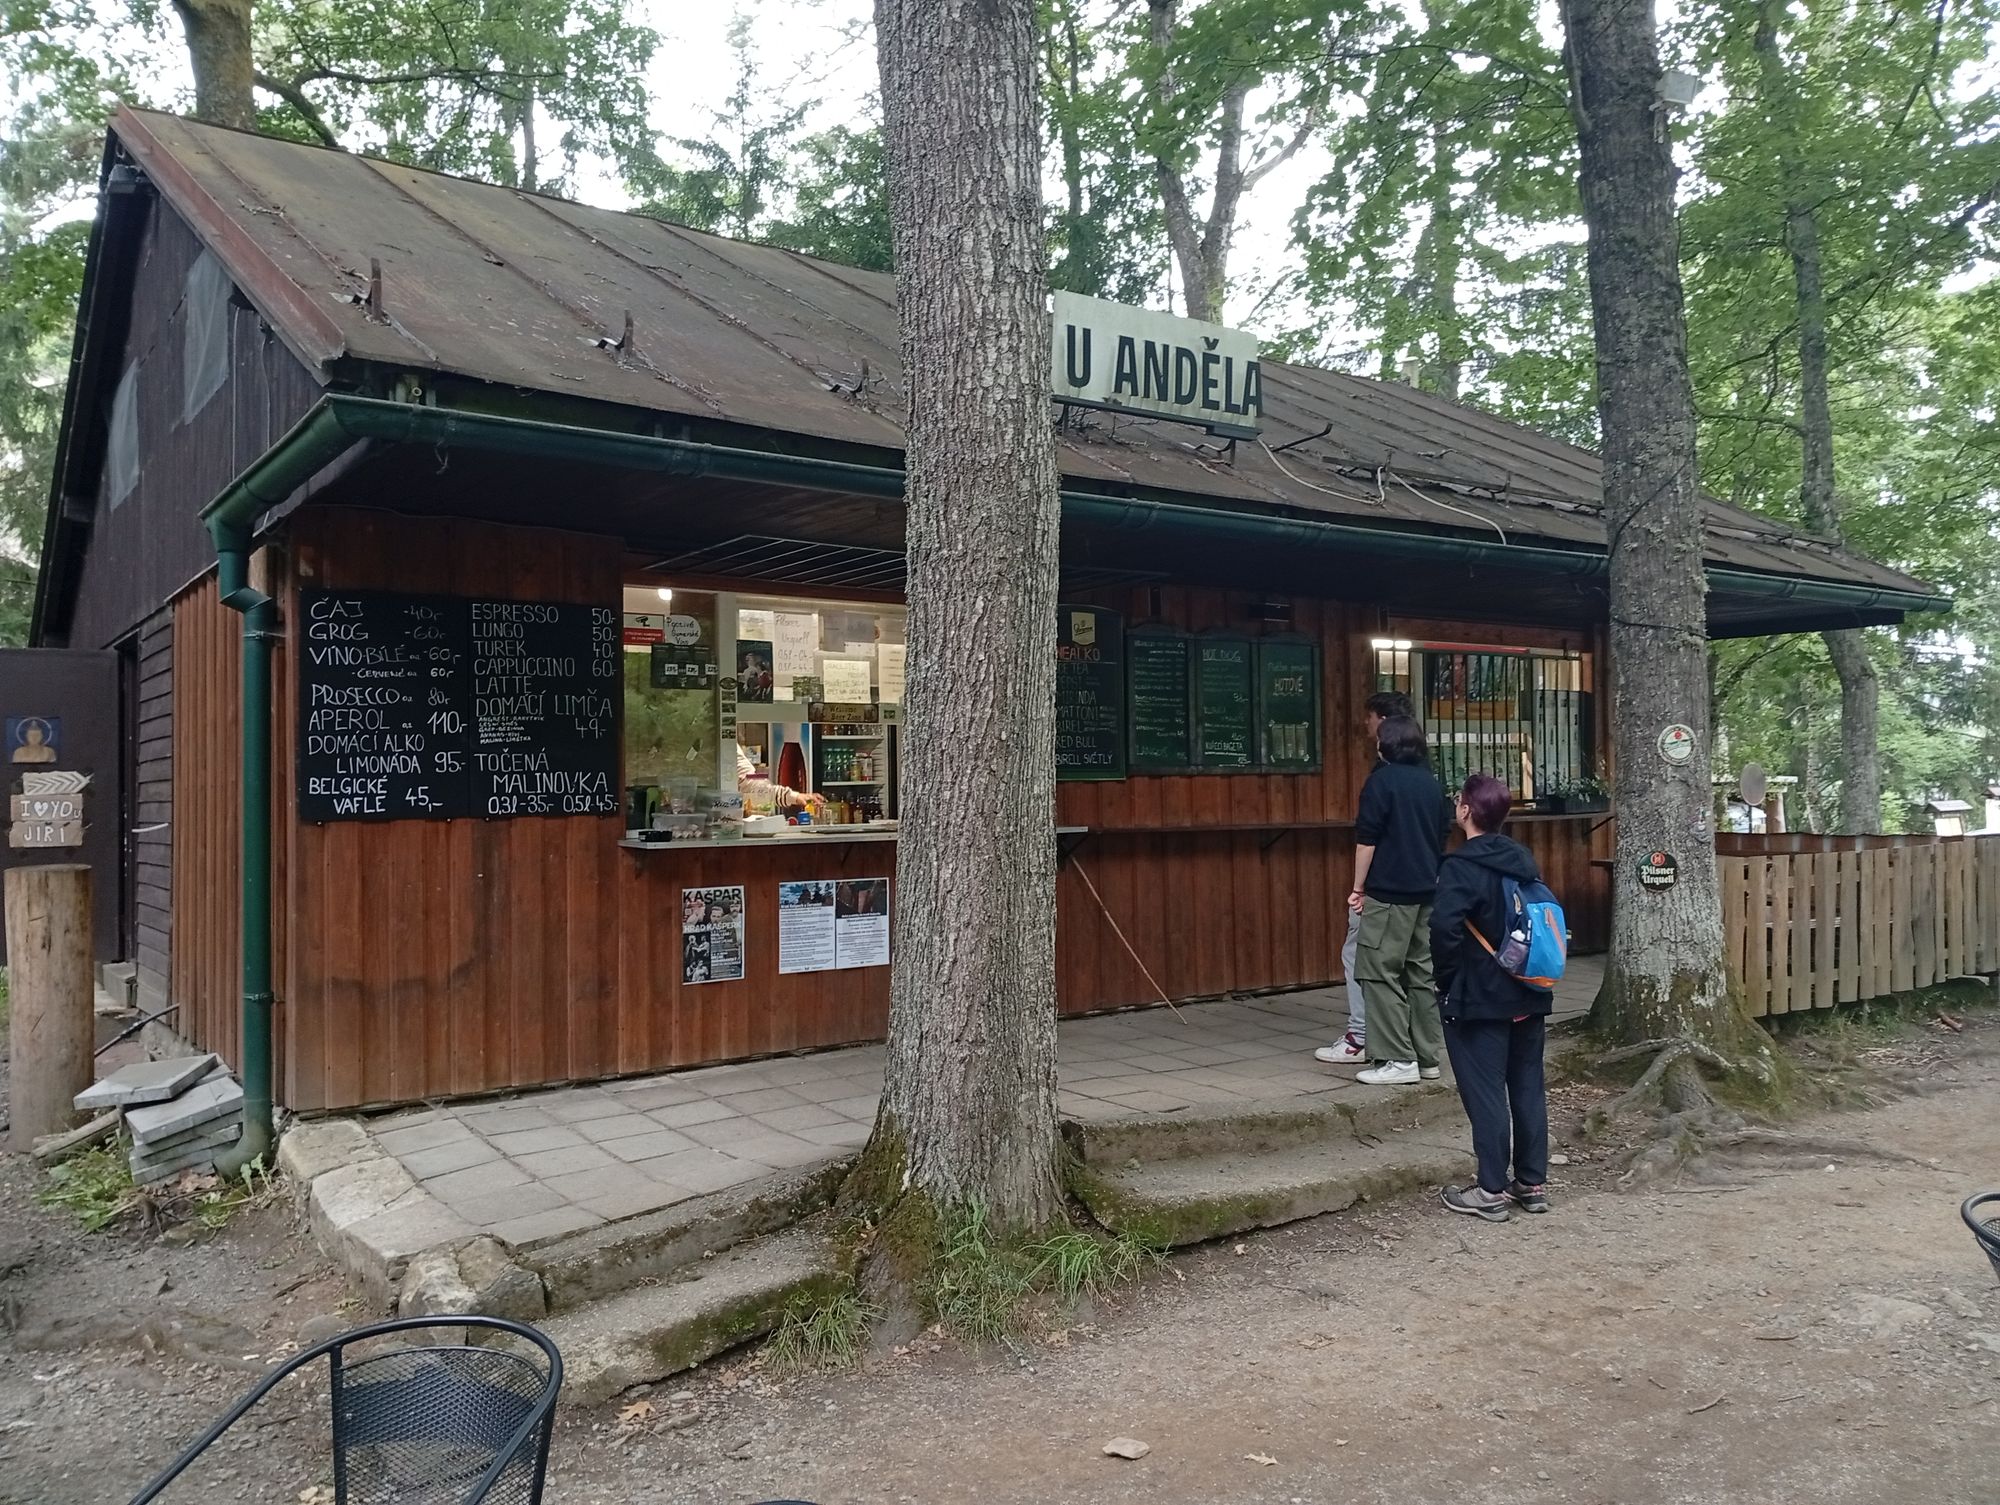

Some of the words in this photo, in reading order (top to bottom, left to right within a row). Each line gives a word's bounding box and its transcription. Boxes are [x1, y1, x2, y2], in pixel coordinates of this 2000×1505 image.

[1066, 324, 1091, 388] U
[1113, 336, 1264, 417] ANDĚLA
[310, 597, 364, 620] ČAJ
[472, 603, 559, 623] ESPRESSO
[309, 622, 369, 641] GROG
[472, 622, 524, 639] LUNGO
[473, 640, 527, 657] TUREK
[474, 657, 575, 677] CAPPUCCINO
[311, 683, 401, 706] PROSECCO
[475, 676, 532, 695] LATTE
[476, 689, 547, 718] DOMÁCÍ
[555, 688, 613, 719] LIMČA
[308, 708, 391, 731] APEROL
[308, 731, 378, 756] DOMÁCÍ
[384, 733, 425, 752] ALKO
[336, 753, 422, 774] LIMONÁDA
[474, 747, 550, 772] TOČENÁ
[309, 775, 388, 795] BELGICKÉ
[493, 771, 608, 794] MALINOVKA
[20, 800, 31, 817] I
[51, 800, 82, 819] YOU
[333, 796, 386, 815] VAFLE
[23, 821, 71, 843] JIŘÍ
[1640, 864, 1675, 876] Pilsner
[1641, 875, 1675, 886] Urquell
[683, 888, 742, 905] KAŠPAR
